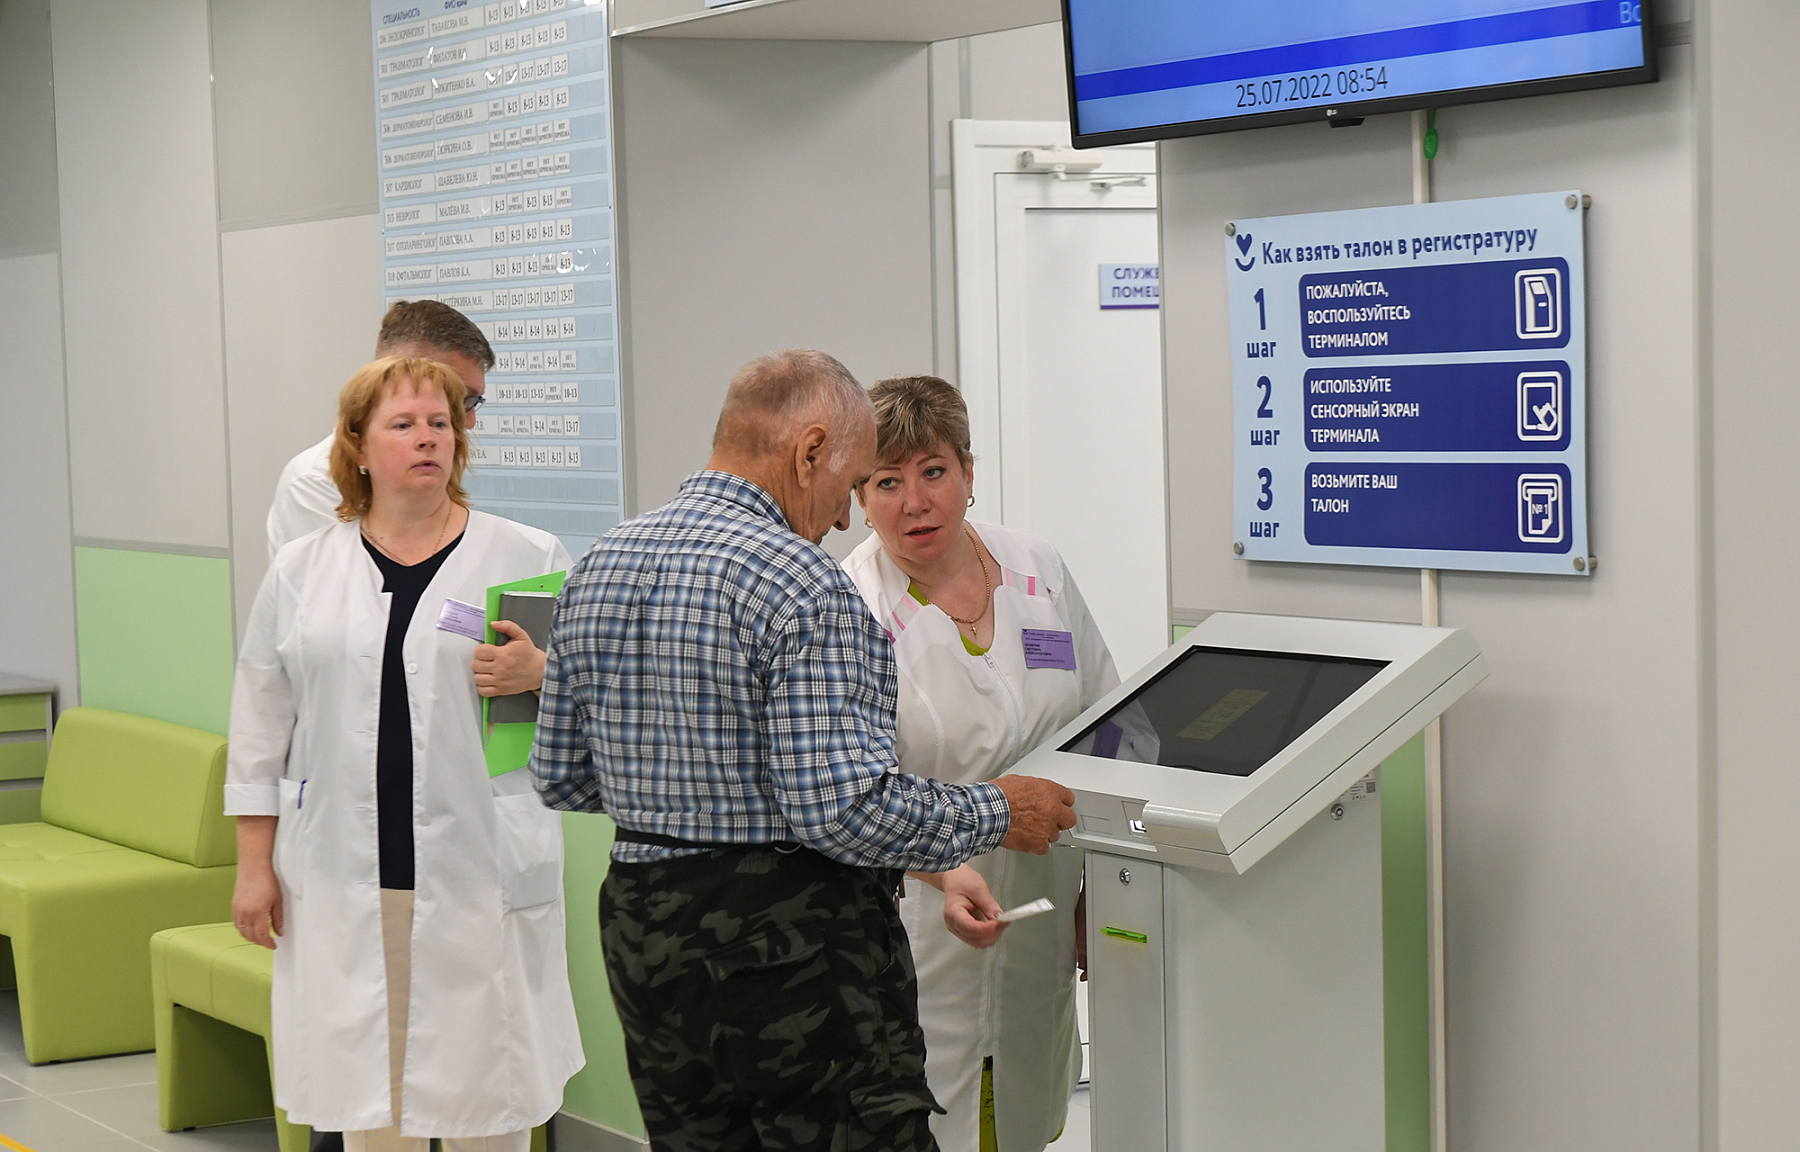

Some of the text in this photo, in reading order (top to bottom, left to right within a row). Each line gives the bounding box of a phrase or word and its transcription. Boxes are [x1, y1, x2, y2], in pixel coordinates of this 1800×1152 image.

[1235, 66, 1388, 107] 25.07.2022 08:54
[1262, 227, 1538, 265] Как взять талон в регистратуру
[1305, 281, 1390, 300] ПОЖАЛУЙСТА,
[1253, 287, 1267, 331] 1
[1307, 304, 1411, 325] ВОСПОЛЬЗУЙТЕСЬ
[1246, 340, 1277, 358] шаг
[1308, 331, 1389, 349] ТЕРМИНАЛОМ
[1310, 376, 1392, 394] ИСПОЛЬЗУЙТЕ
[1256, 375, 1274, 419] 2
[1310, 400, 1419, 419] СЕНСОРНЫЙ ЭКРАН
[1250, 428, 1280, 446] шаг
[1311, 428, 1380, 443] ТЕРМИНАЛА
[1256, 467, 1274, 511] 3
[1311, 474, 1398, 489] ВОЗЬМИТЕ ВАШ
[1311, 498, 1350, 513] ТАЛОН
[1249, 520, 1280, 538] шаг
